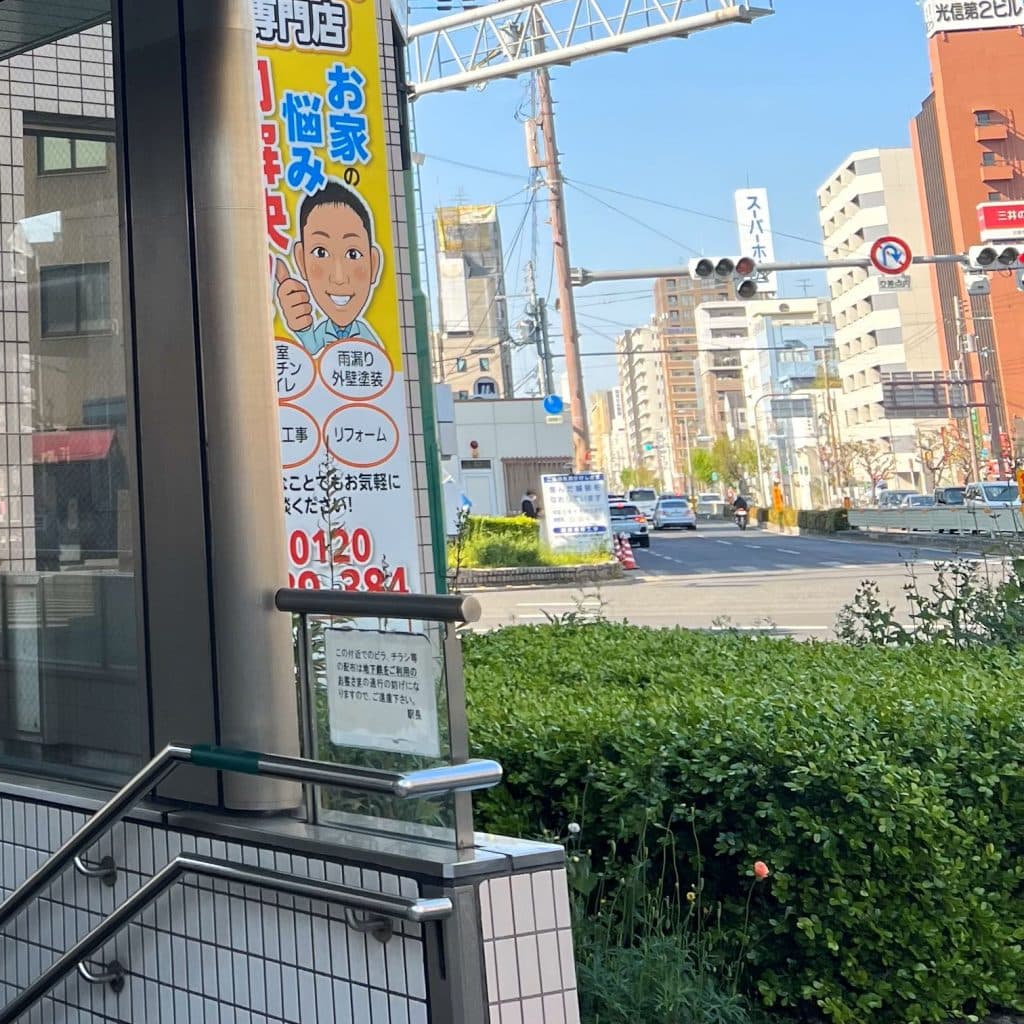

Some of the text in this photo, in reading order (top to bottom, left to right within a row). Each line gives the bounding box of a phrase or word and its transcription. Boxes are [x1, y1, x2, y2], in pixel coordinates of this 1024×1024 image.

[282, 93, 326, 192] 悩み
[337, 350, 374, 368] 雨漏り
[332, 370, 383, 387] 外壁塗装
[282, 426, 308, 443] 工事
[335, 426, 387, 442] リフォーム
[289, 527, 372, 565] 0120
